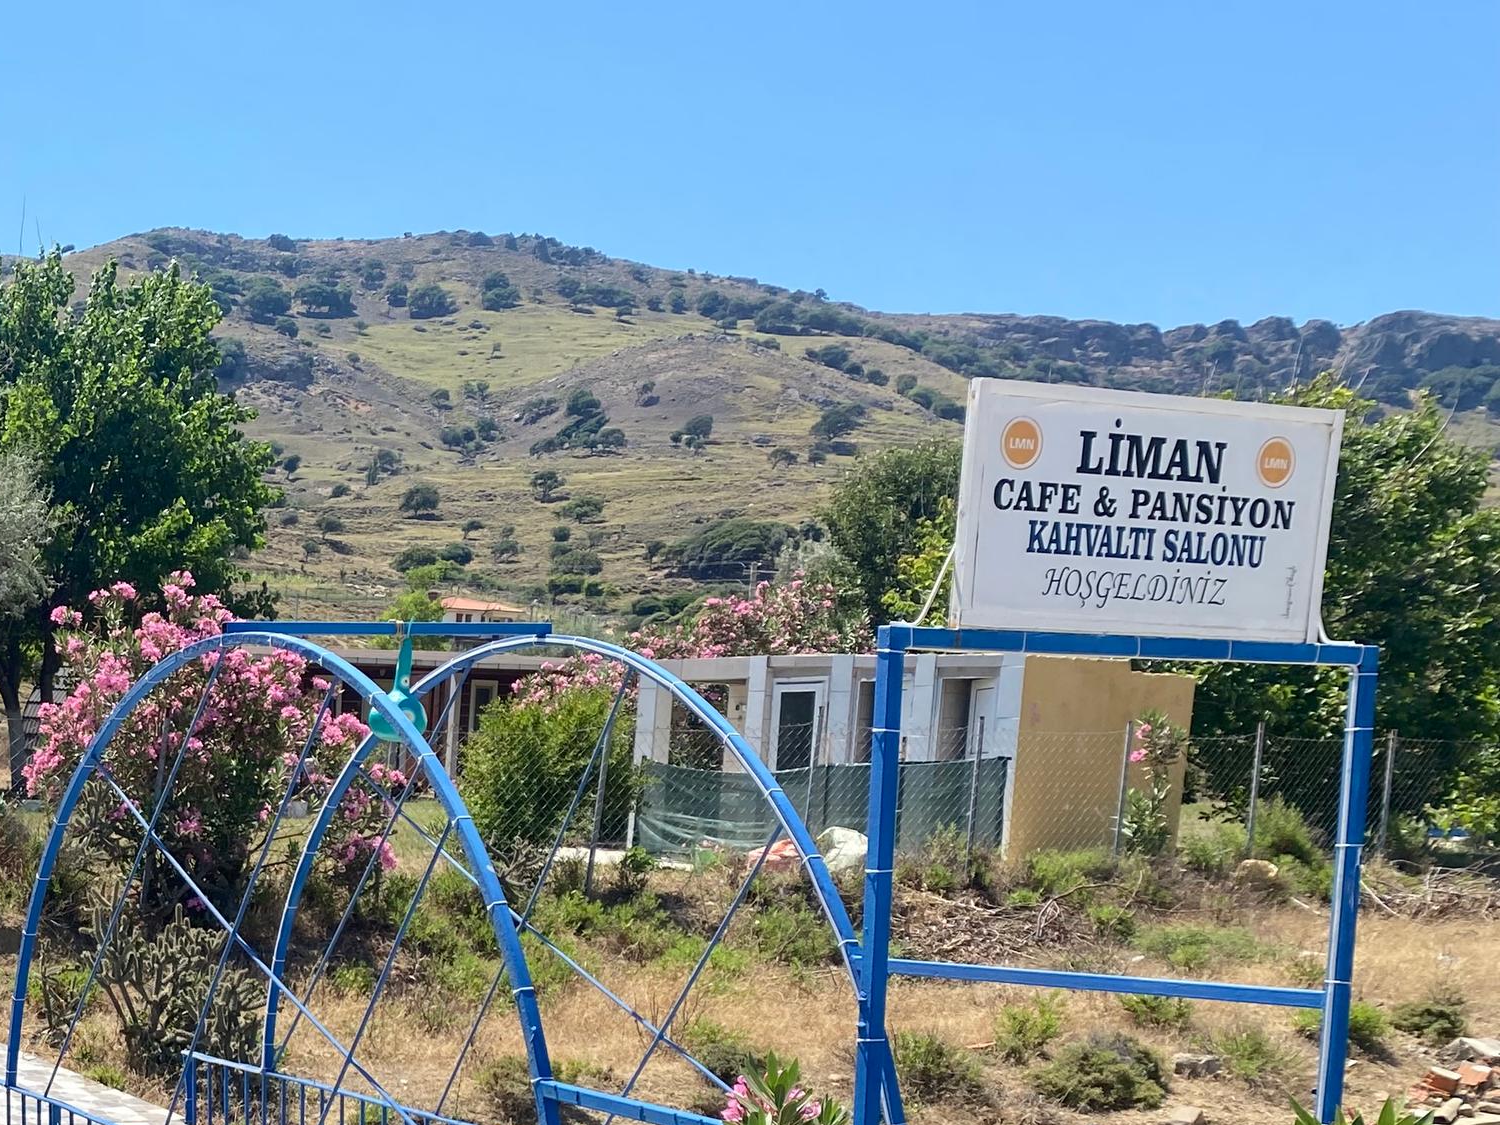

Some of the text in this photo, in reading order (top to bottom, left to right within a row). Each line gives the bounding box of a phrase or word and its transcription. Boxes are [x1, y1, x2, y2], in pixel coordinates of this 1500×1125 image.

[1009, 437, 1035, 450] LMN
[1076, 418, 1228, 484] LİMAN
[993, 478, 1296, 530] CAFE & PANSİYON
[1026, 519, 1267, 569] KAHVALTI SALONU
[1041, 566, 1229, 609] HOŞGELDİNİZ
